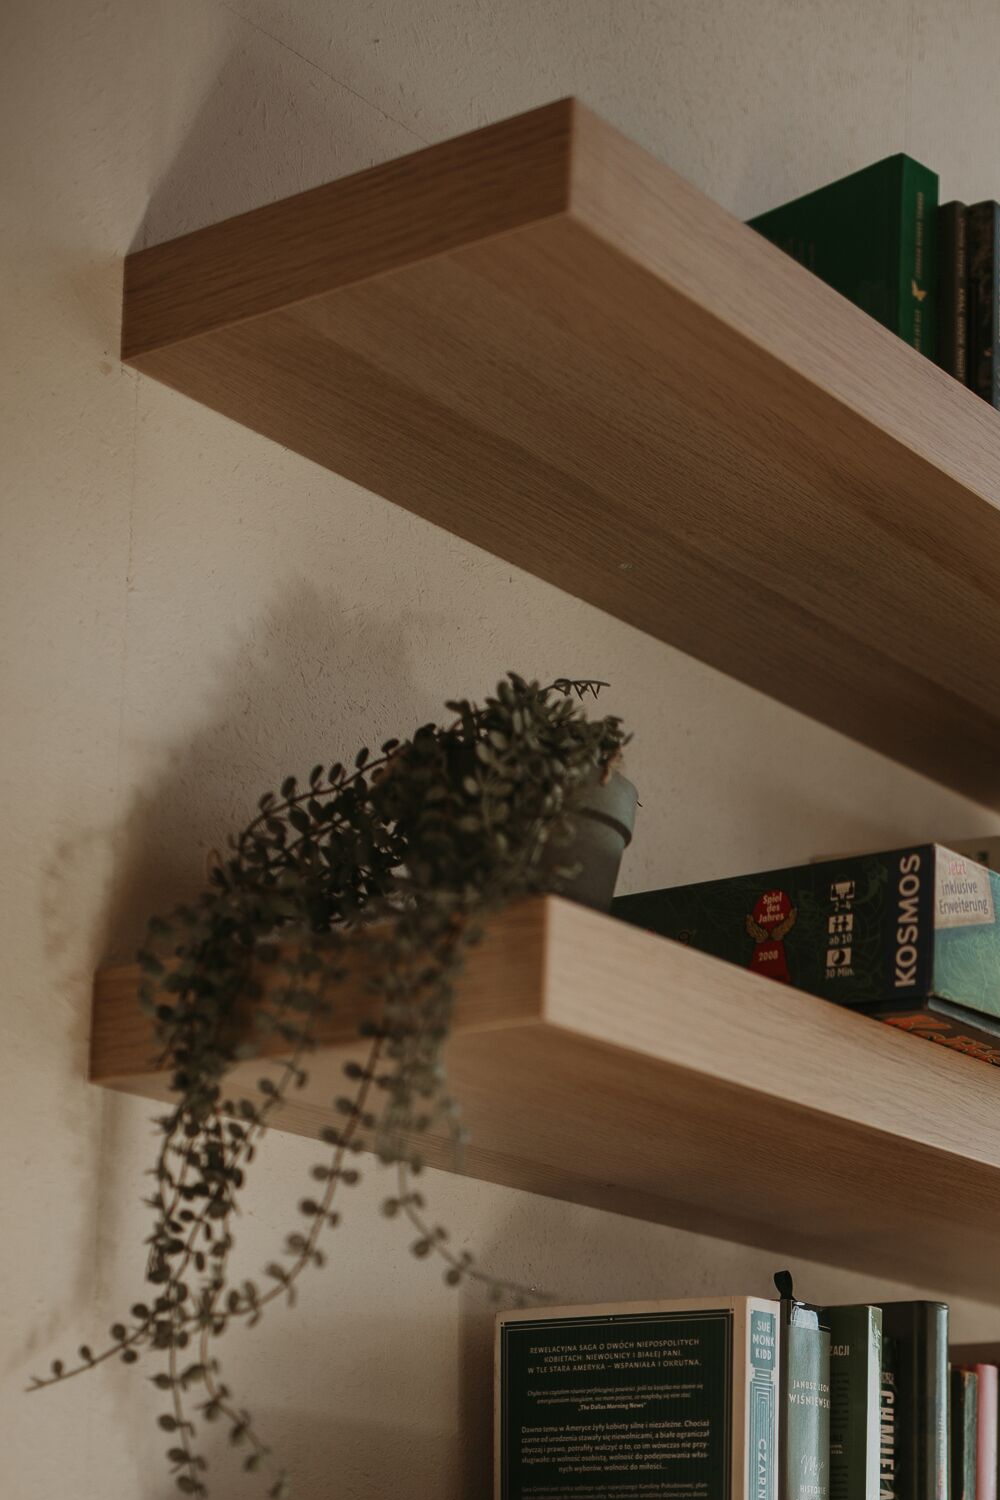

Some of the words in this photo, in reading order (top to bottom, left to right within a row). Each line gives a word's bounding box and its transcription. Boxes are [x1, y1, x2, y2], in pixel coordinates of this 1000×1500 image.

[941, 880, 978, 896] inklusive
[762, 891, 782, 905] Spiel
[766, 903, 780, 912] des
[939, 897, 988, 915] Erweiterung
[758, 912, 785, 924] Jahres
[894, 853, 921, 988] KOSMOS
[841, 933, 853, 944] 10
[758, 950, 779, 962] 2008
[756, 1320, 771, 1333] SUE
[579, 1343, 597, 1352] SAGA
[606, 1340, 635, 1350] DWÓCH
[636, 1338, 700, 1349] NIEPOSPOLITYCH
[752, 1334, 775, 1347] MONK
[586, 1352, 631, 1362] NIEWOLNICY
[755, 1348, 772, 1360] KIDD
[573, 1363, 606, 1372] AMERYKA
[793, 1379, 817, 1391] JANUSZ
[788, 1392, 830, 1409] WIŚNIEWSK
[800, 1484, 827, 1495] HISTORIE
